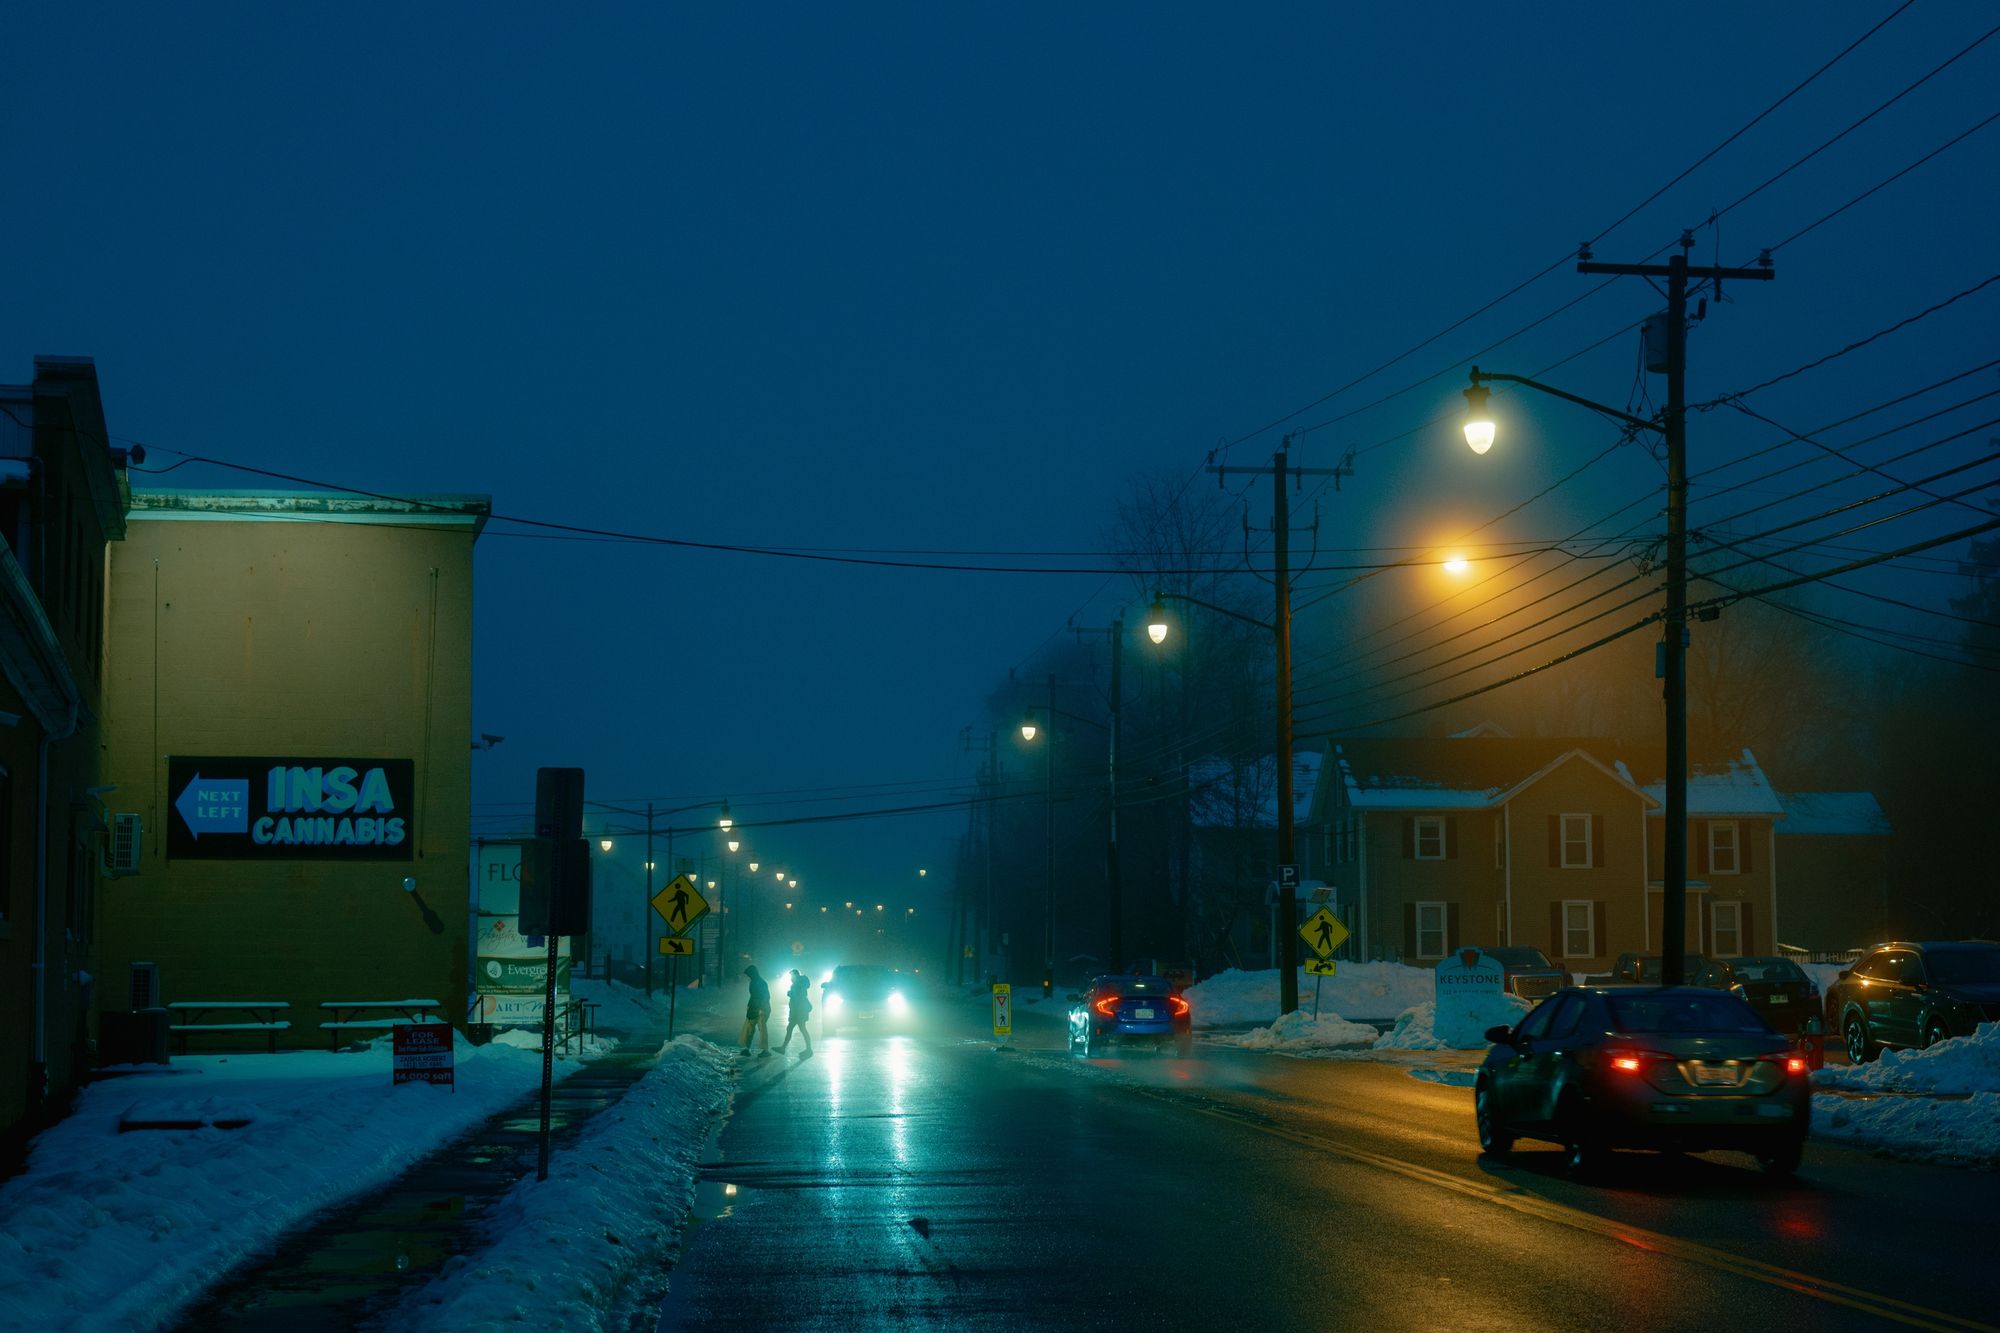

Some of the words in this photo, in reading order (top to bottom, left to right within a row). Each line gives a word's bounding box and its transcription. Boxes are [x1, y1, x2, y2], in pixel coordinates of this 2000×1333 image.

[198, 790, 241, 802] NEXT
[268, 766, 395, 814] INSA
[198, 806, 242, 818] LEFT
[252, 817, 405, 845] CANNABIS
[1283, 867, 1295, 882] P
[508, 964, 548, 977] Evergre
[1440, 974, 1500, 985] KEYSTONE
